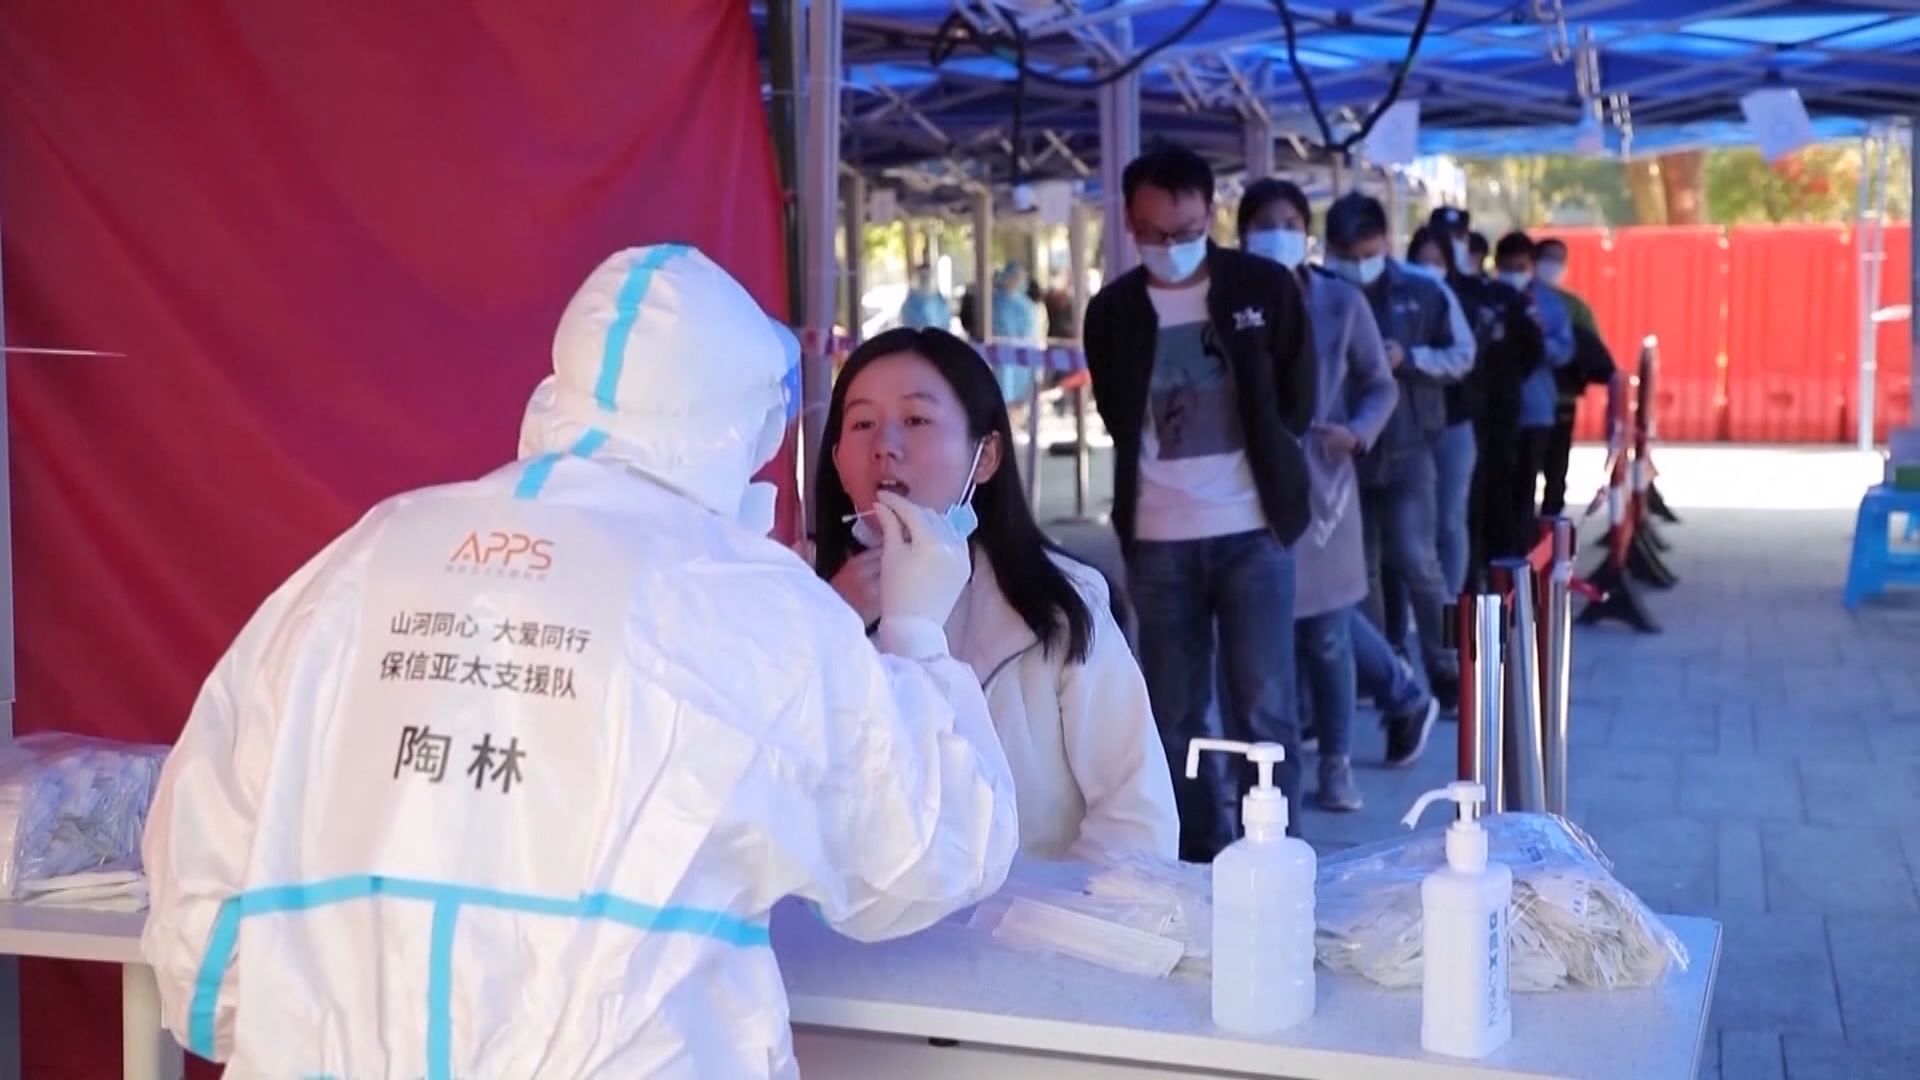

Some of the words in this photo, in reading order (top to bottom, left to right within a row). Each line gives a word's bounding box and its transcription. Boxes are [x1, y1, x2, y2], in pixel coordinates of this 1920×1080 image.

[450, 531, 555, 571] APPS
[390, 611, 479, 639] 山河同心
[492, 619, 591, 654] 大爱同行
[380, 651, 577, 700] 保信亚太支援队
